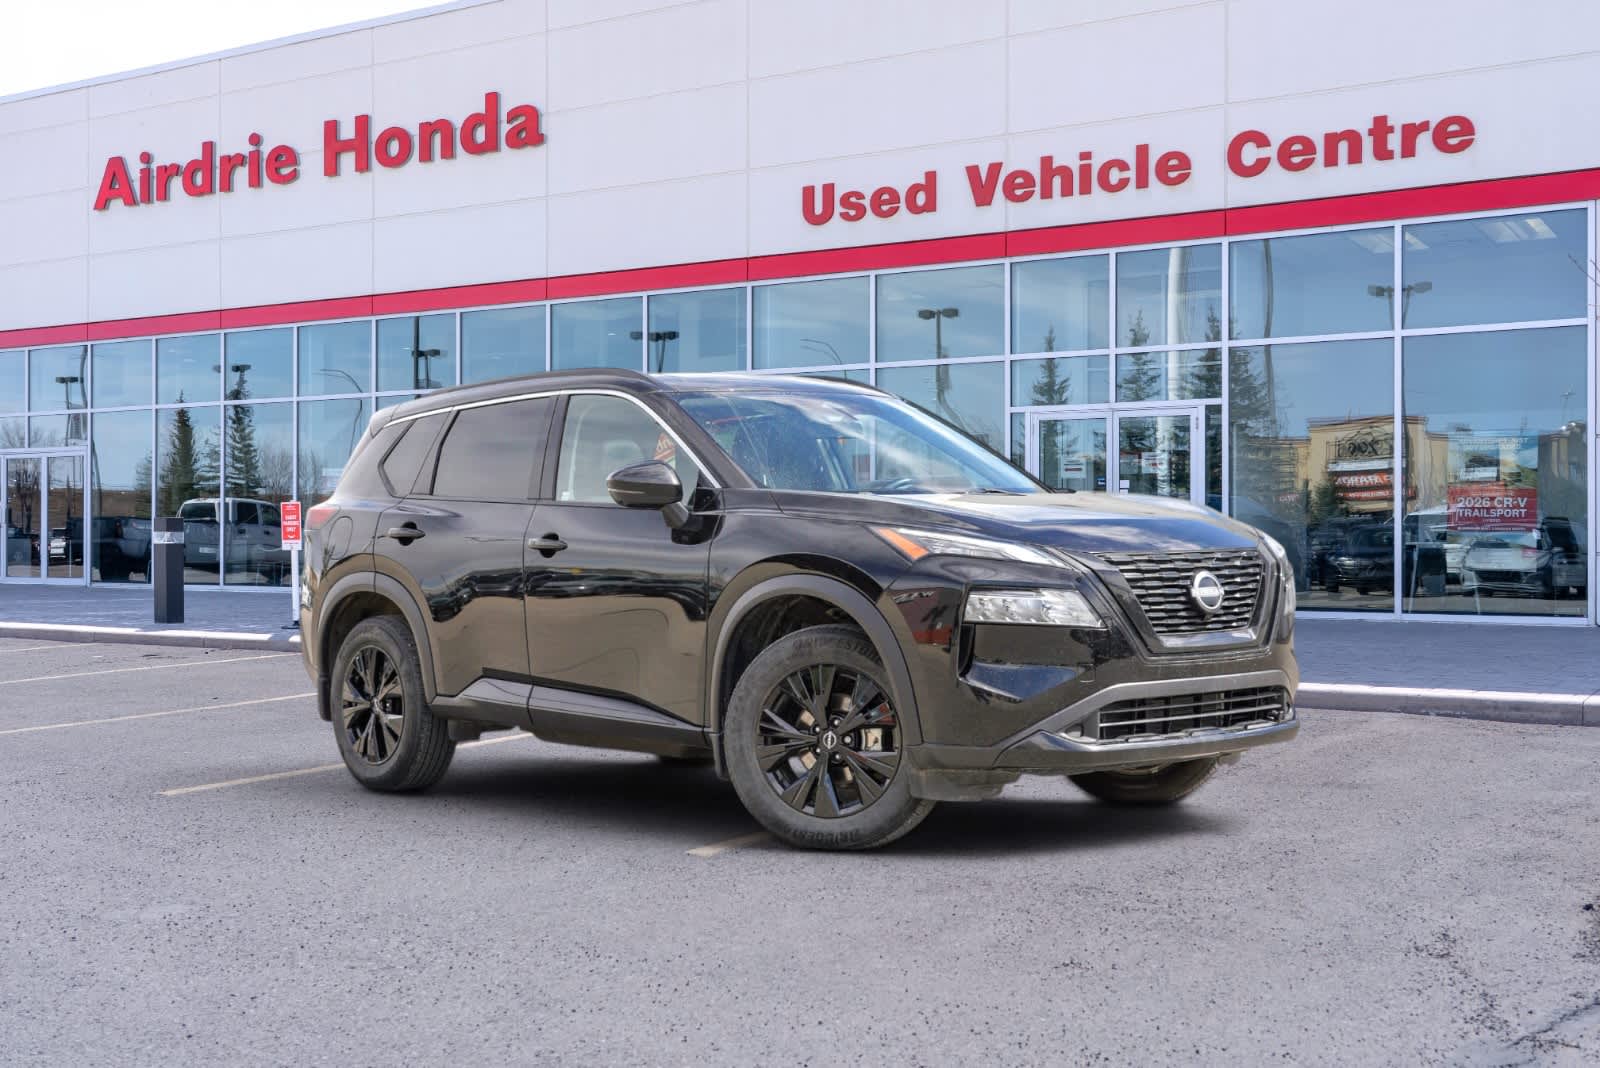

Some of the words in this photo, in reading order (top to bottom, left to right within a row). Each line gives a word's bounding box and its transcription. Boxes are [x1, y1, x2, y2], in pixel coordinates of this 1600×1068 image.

[94, 132, 298, 210] Airdrie
[323, 91, 546, 177] Honda
[801, 170, 937, 226] Used
[966, 143, 1192, 207] Vehicle
[1227, 114, 1476, 178] Centre
[1457, 497, 1489, 507] 2026
[1494, 497, 1527, 507] CR-V
[1458, 509, 1527, 517] TRAILSPORT
